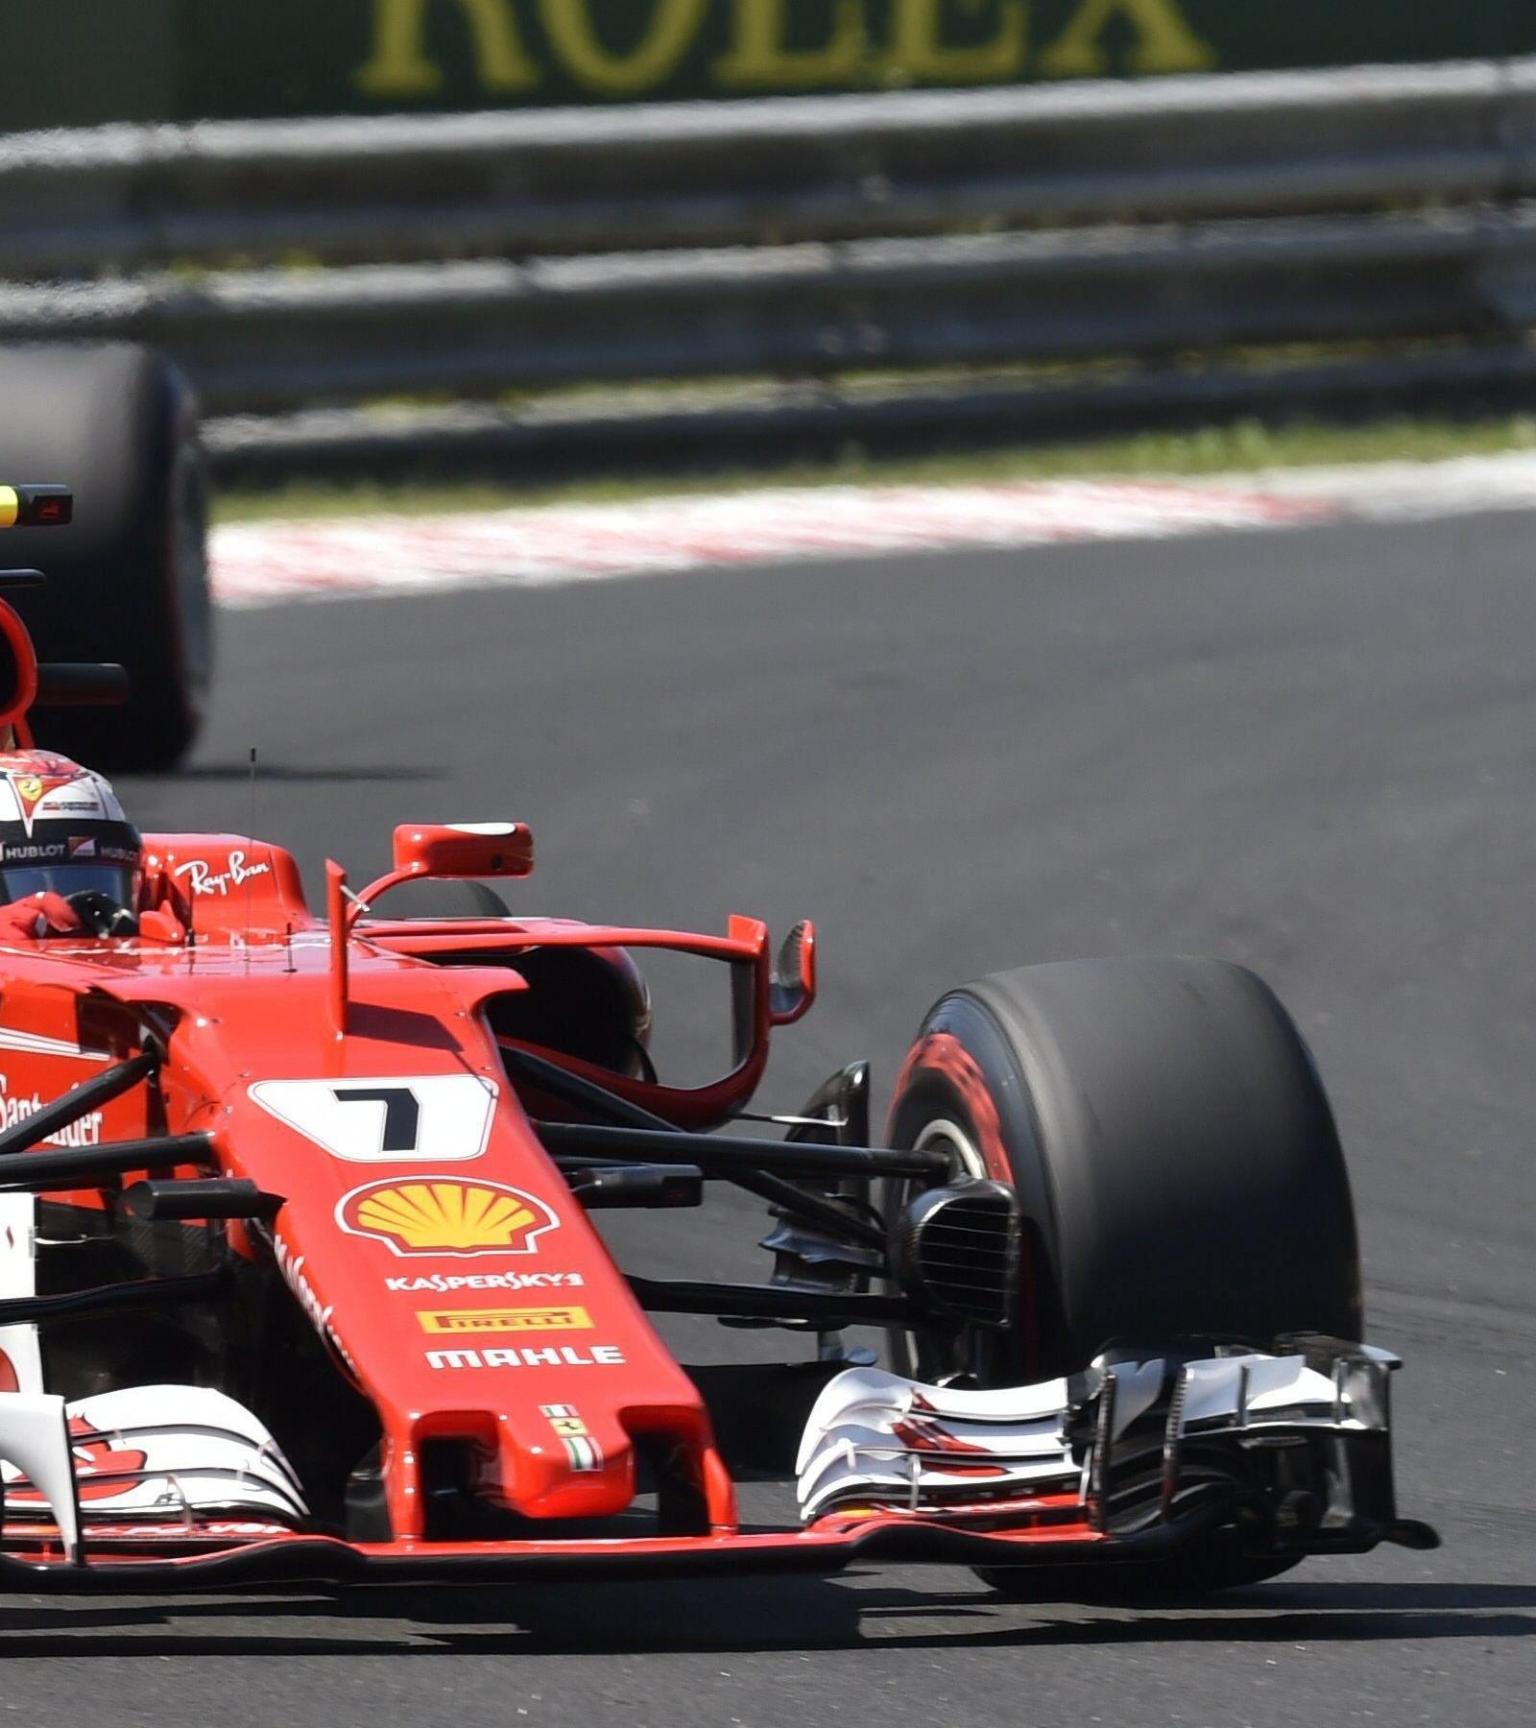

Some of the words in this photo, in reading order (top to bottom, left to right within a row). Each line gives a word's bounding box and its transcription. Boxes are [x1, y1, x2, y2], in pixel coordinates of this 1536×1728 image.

[5, 844, 66, 860] HUBLOT
[174, 850, 270, 896] Ray-Ban
[330, 1088, 420, 1152] 7
[383, 1272, 572, 1292] KASPERSKY
[434, 1311, 577, 1329] PIRELLI
[425, 1346, 627, 1370] MAHLE
